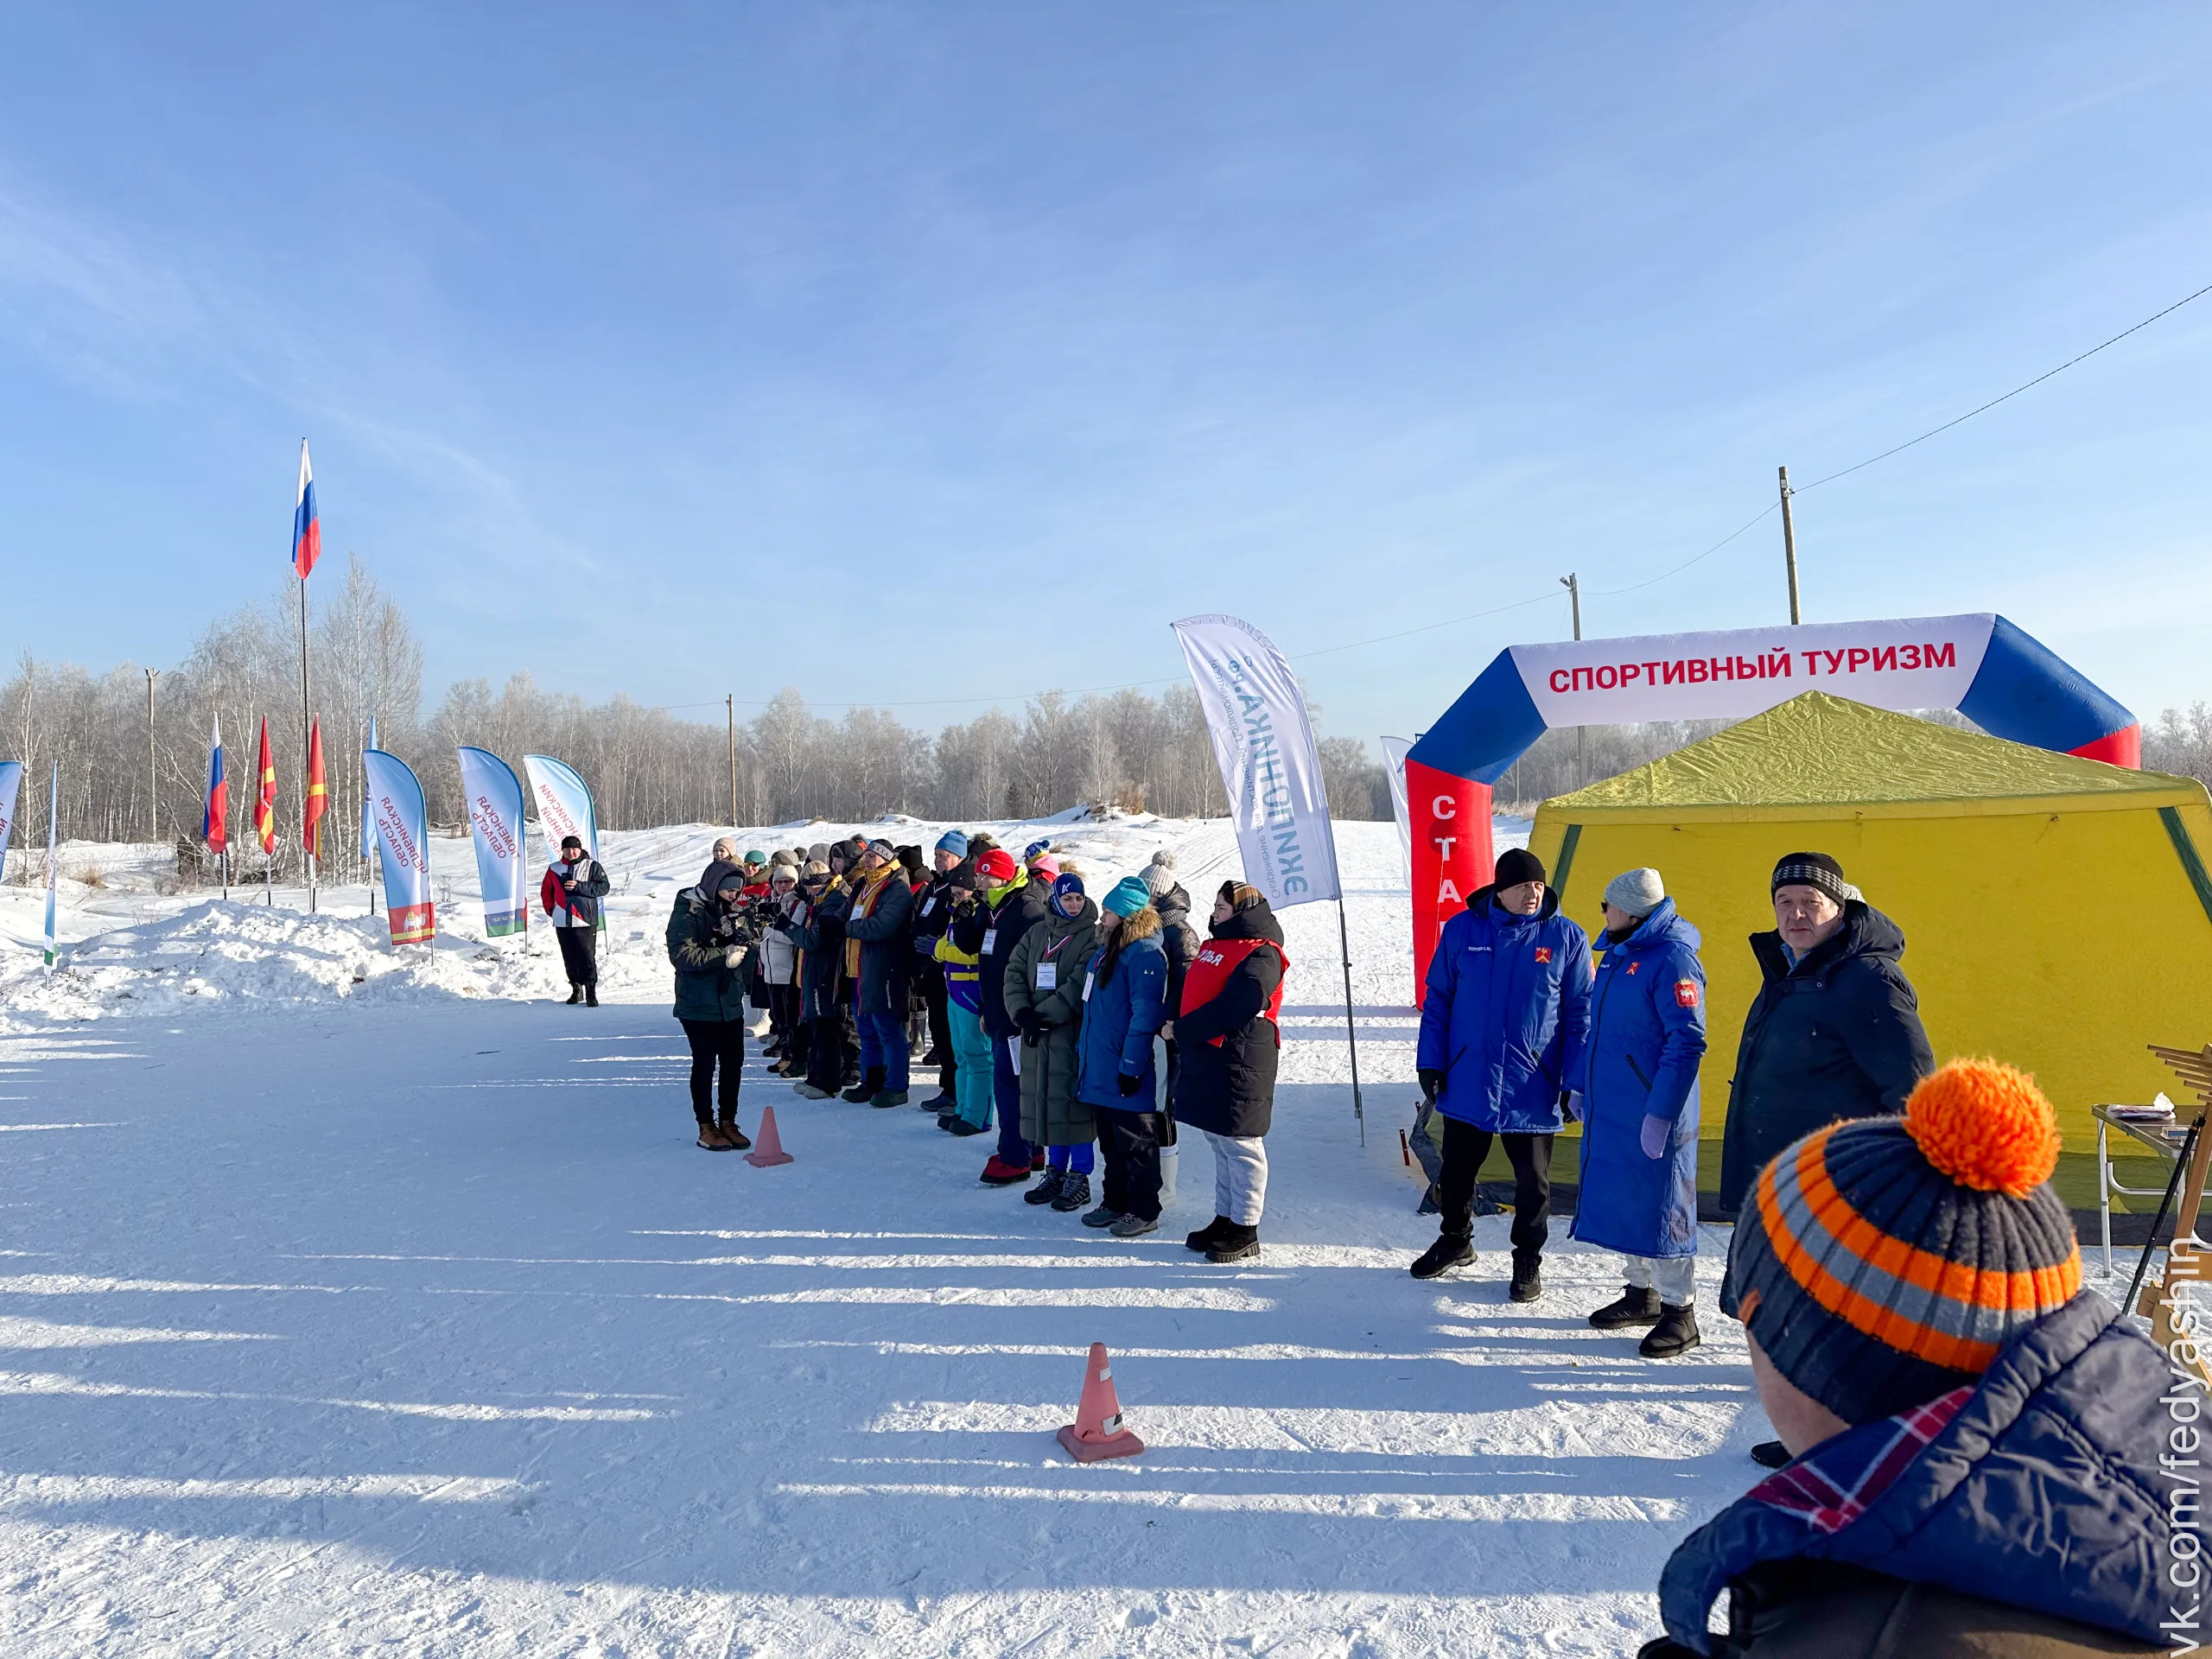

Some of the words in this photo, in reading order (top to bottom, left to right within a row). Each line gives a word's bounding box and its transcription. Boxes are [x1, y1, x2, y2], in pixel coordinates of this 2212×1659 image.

[1549, 647, 1791, 693] СПОРТИВНЫЙ
[1802, 642, 1957, 676] ТУРИЗМ
[1432, 794, 1462, 937] СТА
